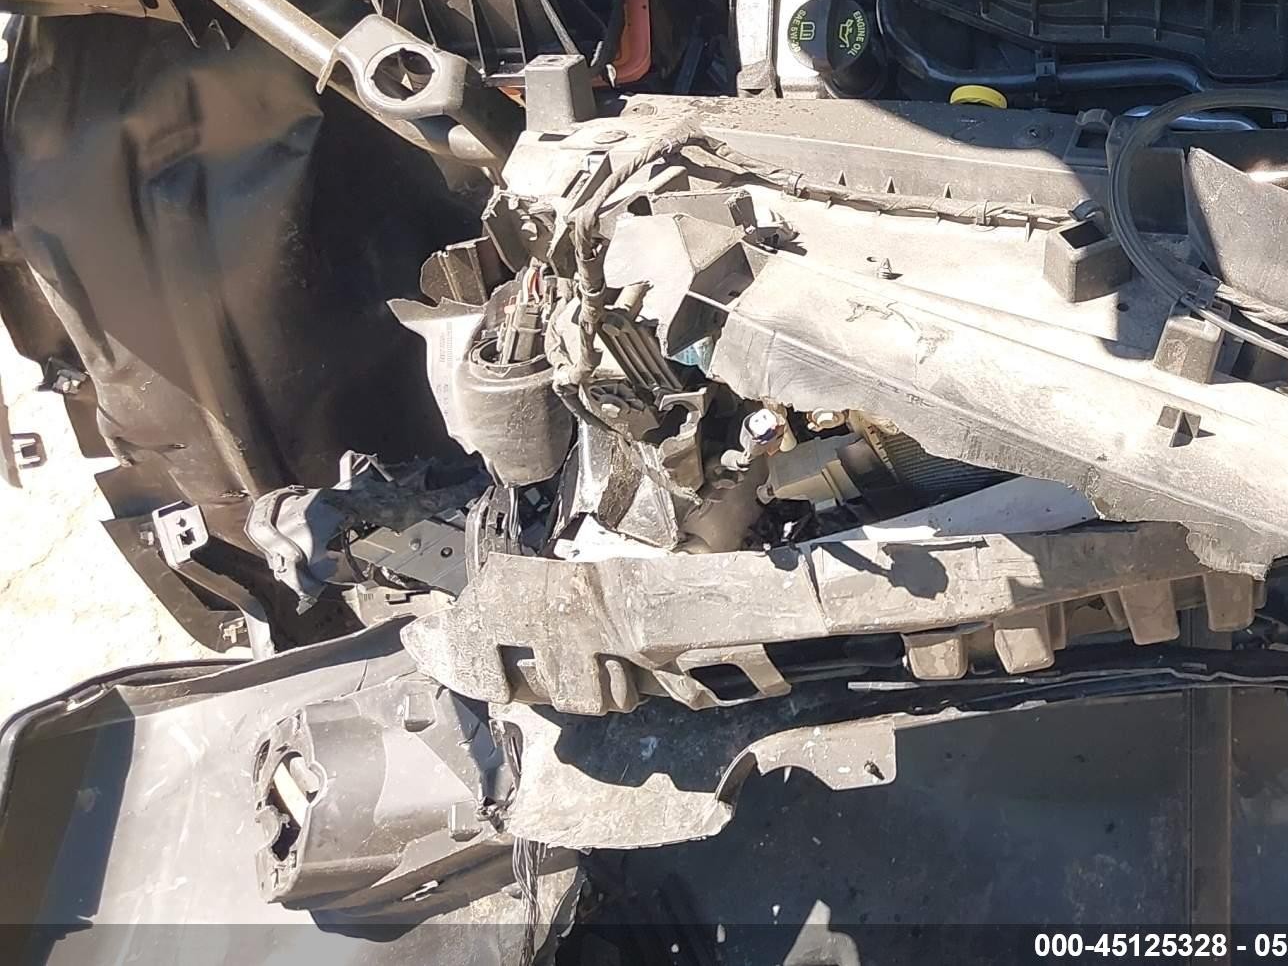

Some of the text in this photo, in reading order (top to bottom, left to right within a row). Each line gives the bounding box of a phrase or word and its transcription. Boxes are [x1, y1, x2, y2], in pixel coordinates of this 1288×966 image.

[790, 9, 807, 53] SAE 5W-20
[848, 10, 866, 56] ENGINE OIL
